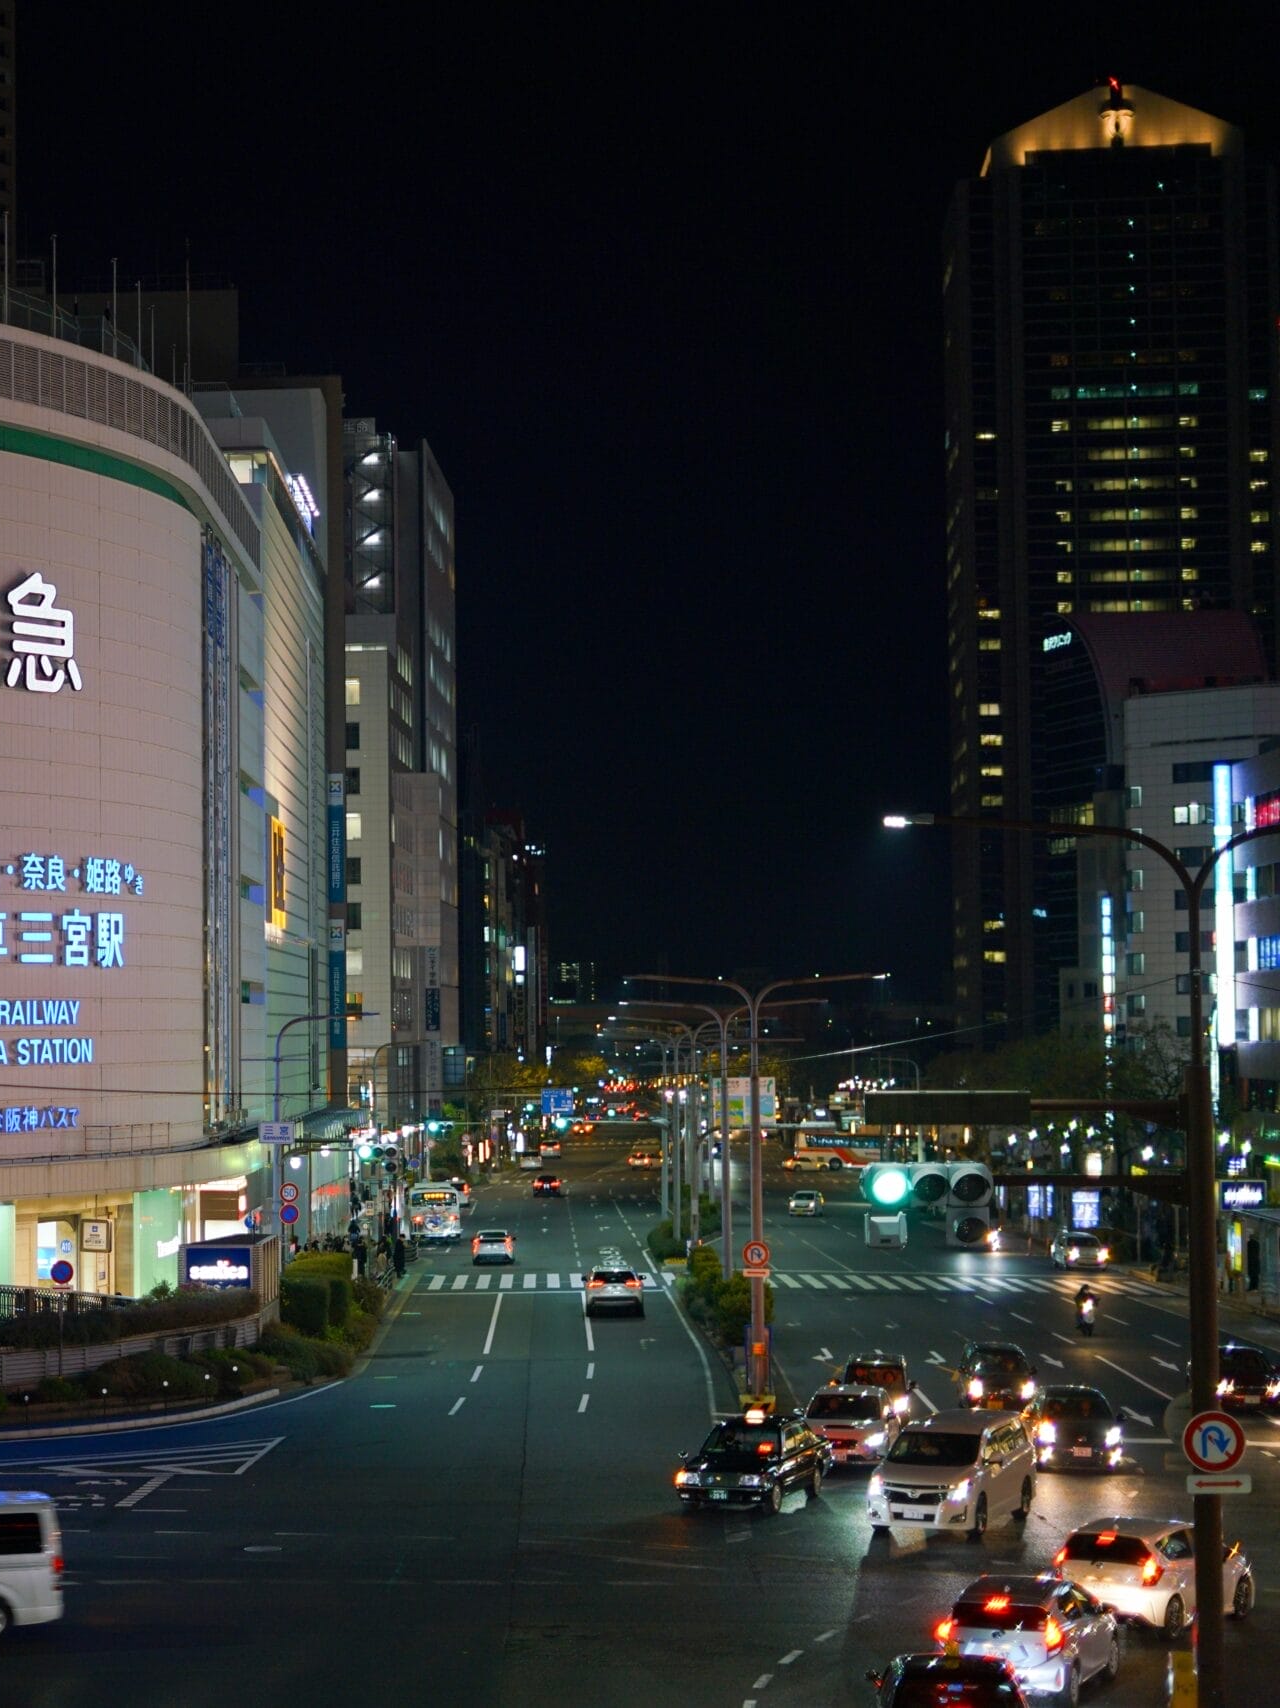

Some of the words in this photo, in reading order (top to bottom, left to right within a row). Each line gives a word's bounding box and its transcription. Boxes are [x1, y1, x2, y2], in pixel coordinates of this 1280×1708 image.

[17, 1038, 93, 1064] STATION
[264, 1125, 289, 1136] 三宮
[284, 1188, 295, 1197] 50
